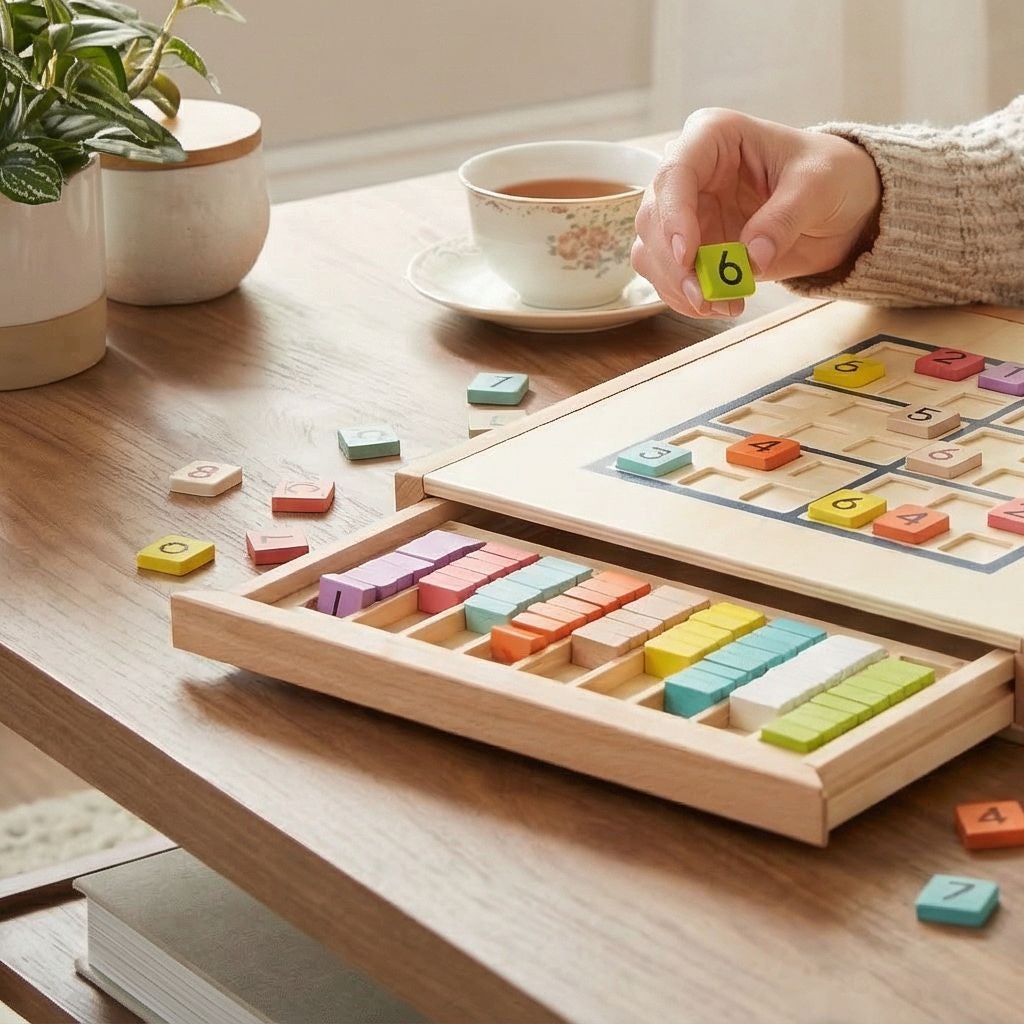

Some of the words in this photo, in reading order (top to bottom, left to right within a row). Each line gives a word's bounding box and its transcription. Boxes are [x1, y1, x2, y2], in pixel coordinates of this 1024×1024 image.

[719, 250, 743, 286] 6
[934, 351, 967, 365] 2
[907, 407, 942, 422] 5
[748, 440, 782, 453] 4
[928, 448, 960, 461] 6
[831, 497, 863, 510] 6
[896, 511, 928, 526] 4
[978, 807, 1007, 824] 4
[942, 880, 976, 900] 7
